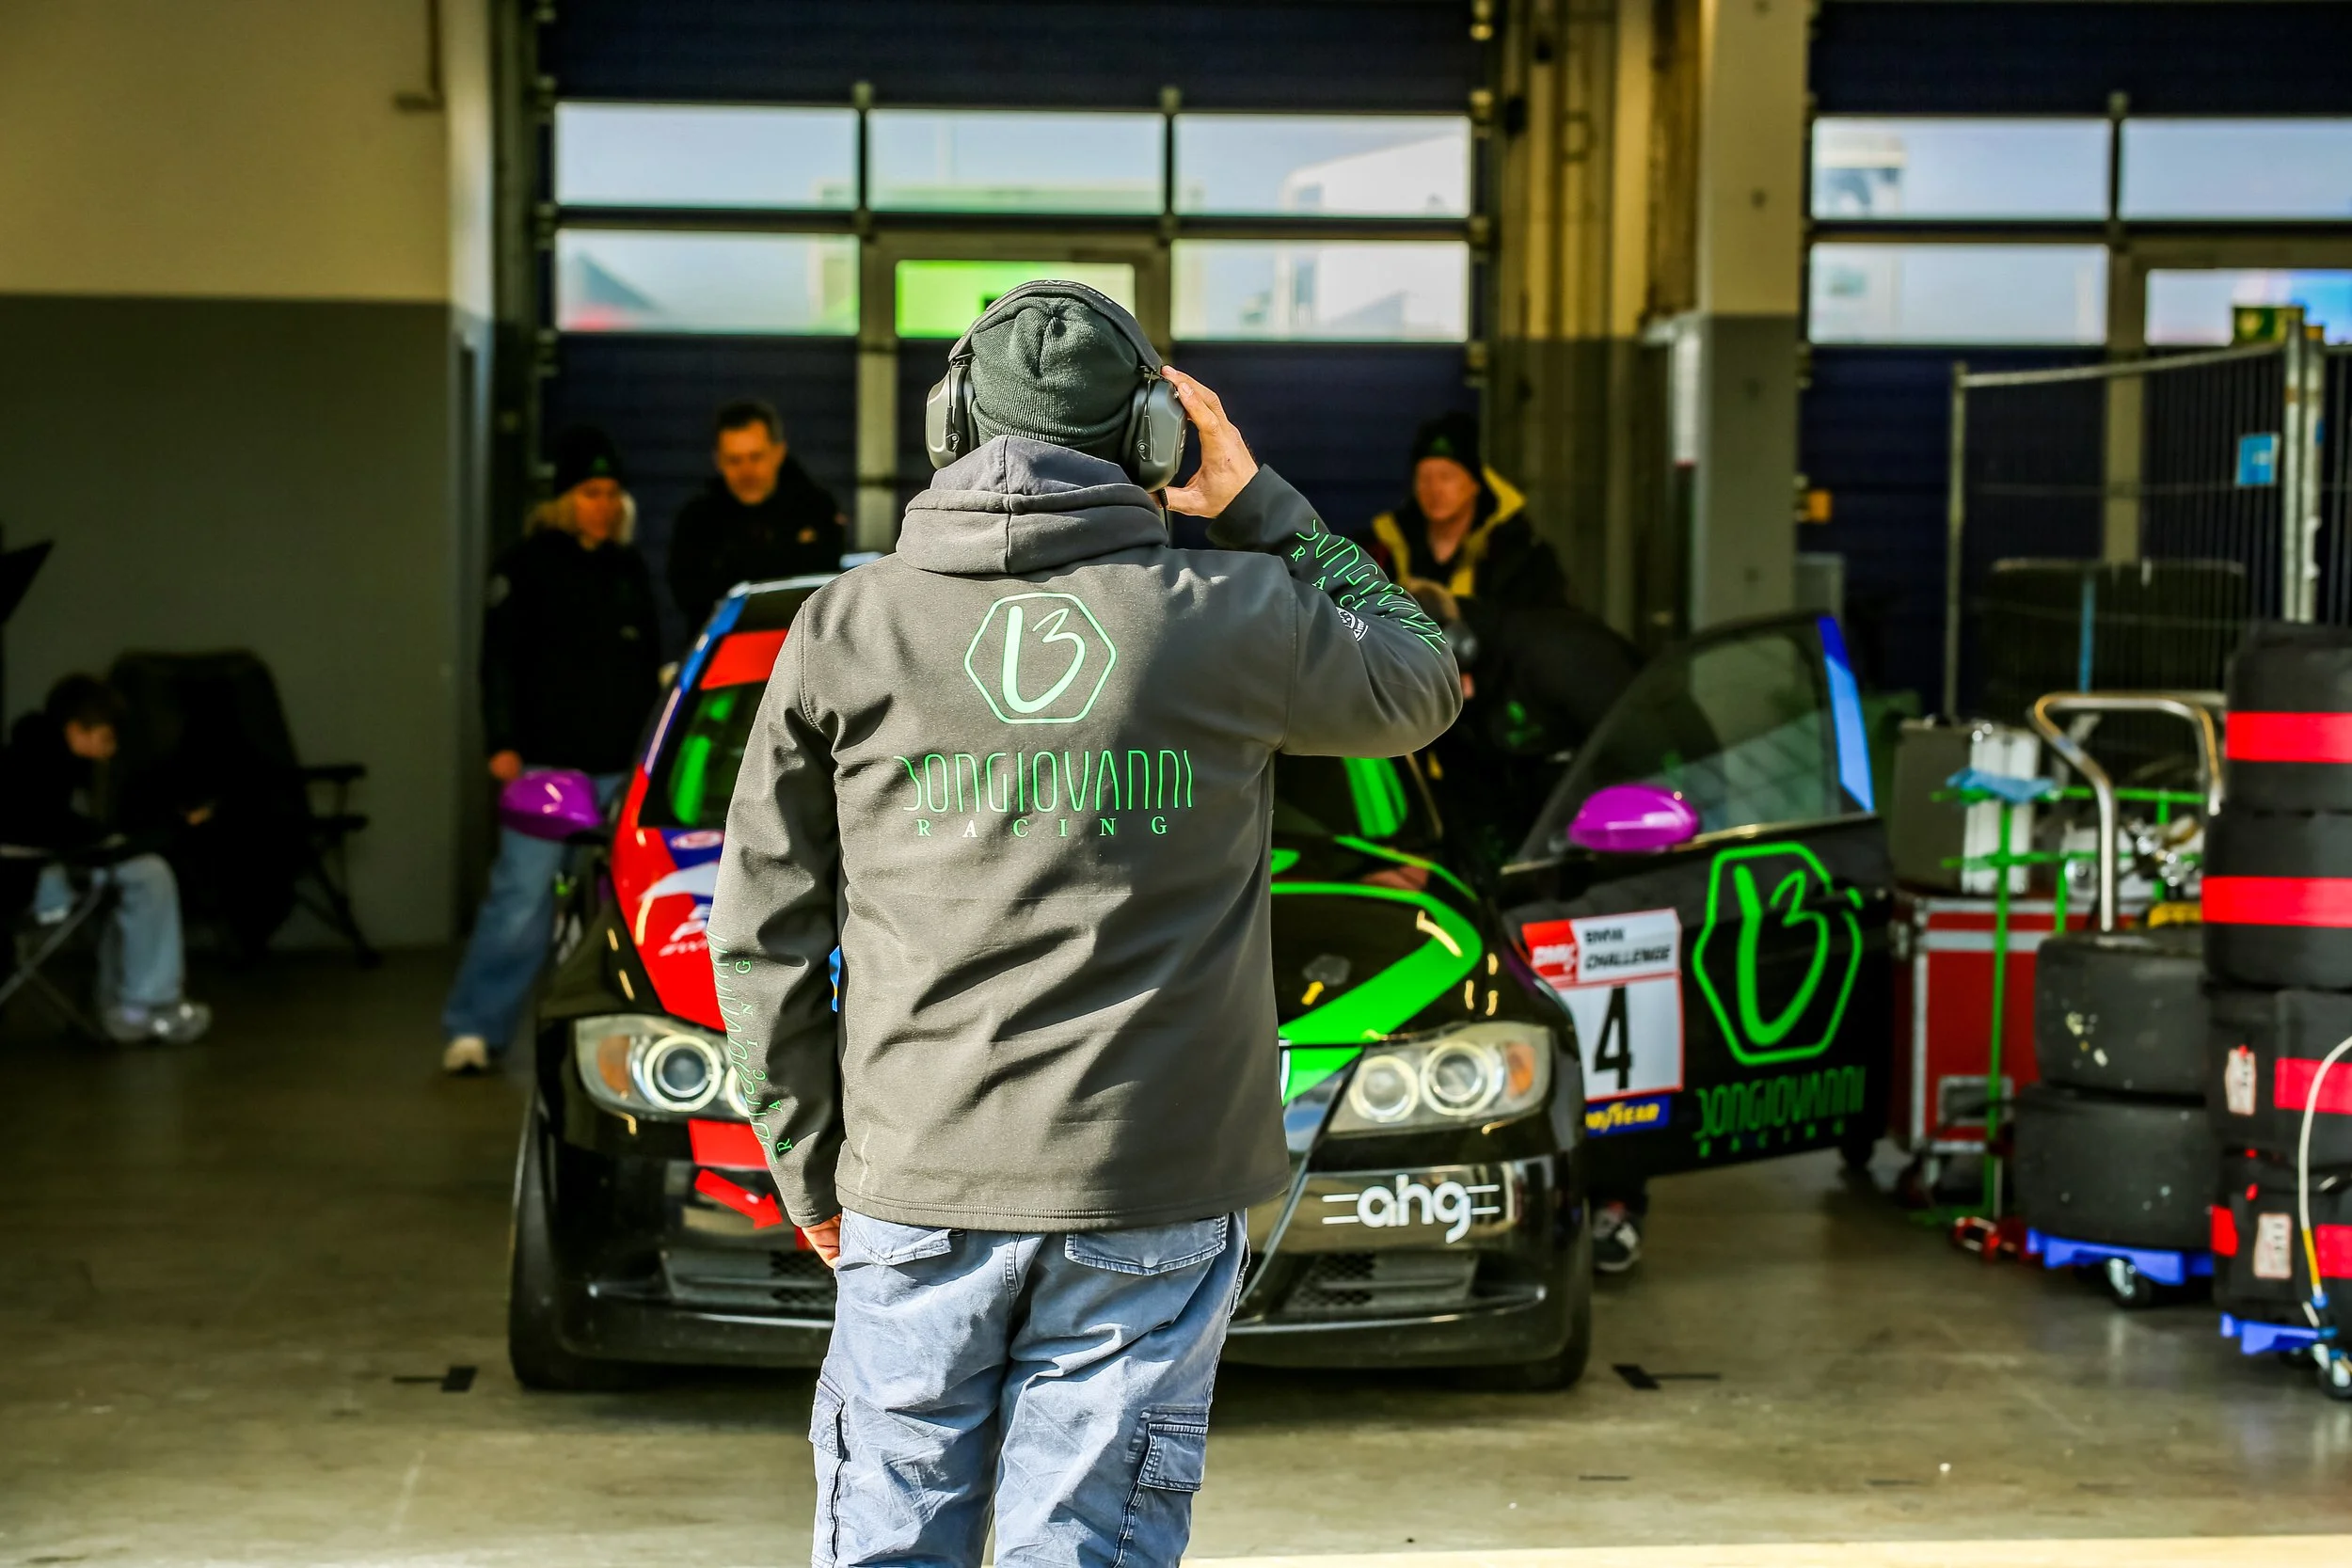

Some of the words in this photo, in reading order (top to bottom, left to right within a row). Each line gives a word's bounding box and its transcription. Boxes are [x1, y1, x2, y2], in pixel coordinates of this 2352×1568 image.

[1290, 545, 1368, 611] RACI
[916, 816, 1168, 839] RACING
[1584, 944, 1671, 970] CHALLENGE
[735, 958, 794, 1153] RACING
[1594, 984, 1633, 1090] 4
[1357, 1173, 1472, 1244] ahg
